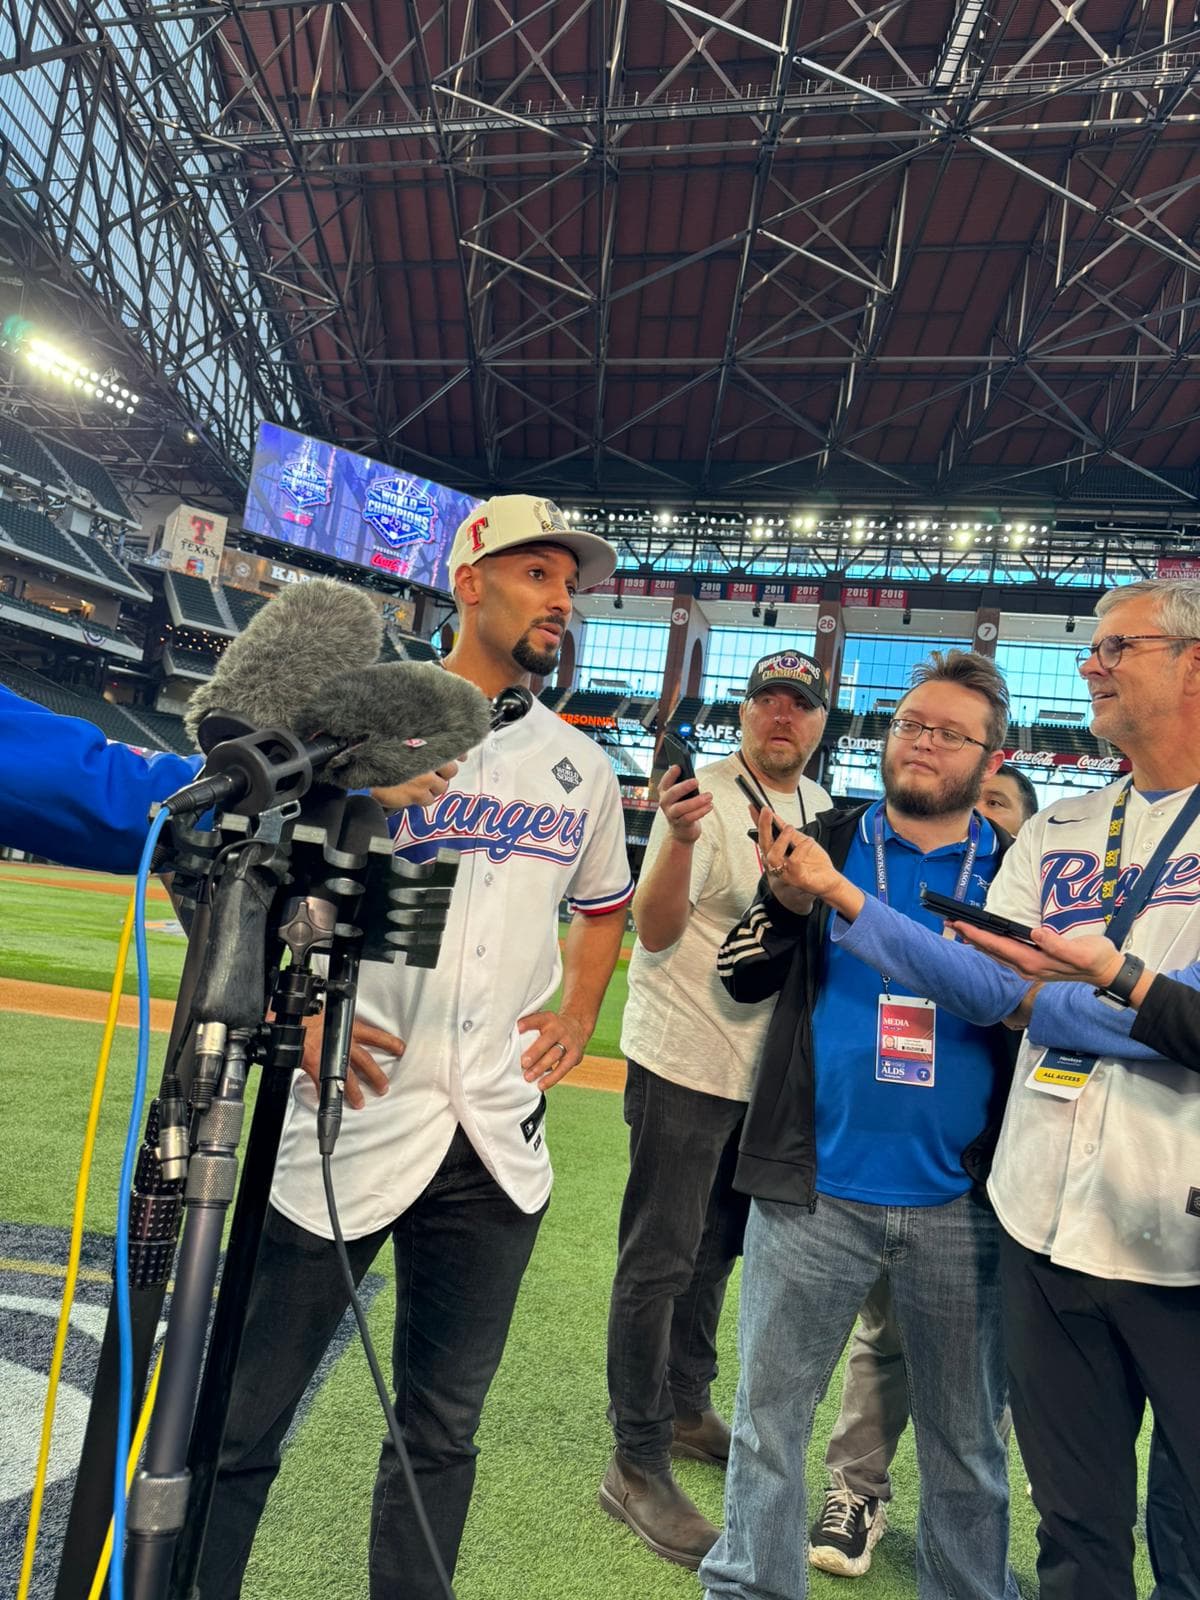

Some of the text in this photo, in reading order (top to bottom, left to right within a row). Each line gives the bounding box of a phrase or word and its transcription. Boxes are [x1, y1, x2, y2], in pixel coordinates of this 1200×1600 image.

[381, 489, 418, 510] WORLD
[367, 500, 429, 531] CHAMPIONS
[466, 517, 488, 552] T
[701, 582, 721, 592] 2010
[733, 583, 752, 593] 2011
[765, 585, 785, 594] 2011
[797, 586, 819, 596] 2012
[847, 588, 869, 598] 2015
[880, 589, 904, 599] 2016
[673, 611, 688, 622] 34
[820, 619, 834, 629] 26
[557, 712, 616, 729] ERSONNEL
[695, 723, 735, 740] SAFE
[1011, 749, 1056, 766] Coca-Cola
[1077, 755, 1123, 771] Coca-Cola
[883, 1017, 909, 1027] MEDIA
[881, 1066, 905, 1076] ALDS
[1056, 1074, 1080, 1082] ACCESS
